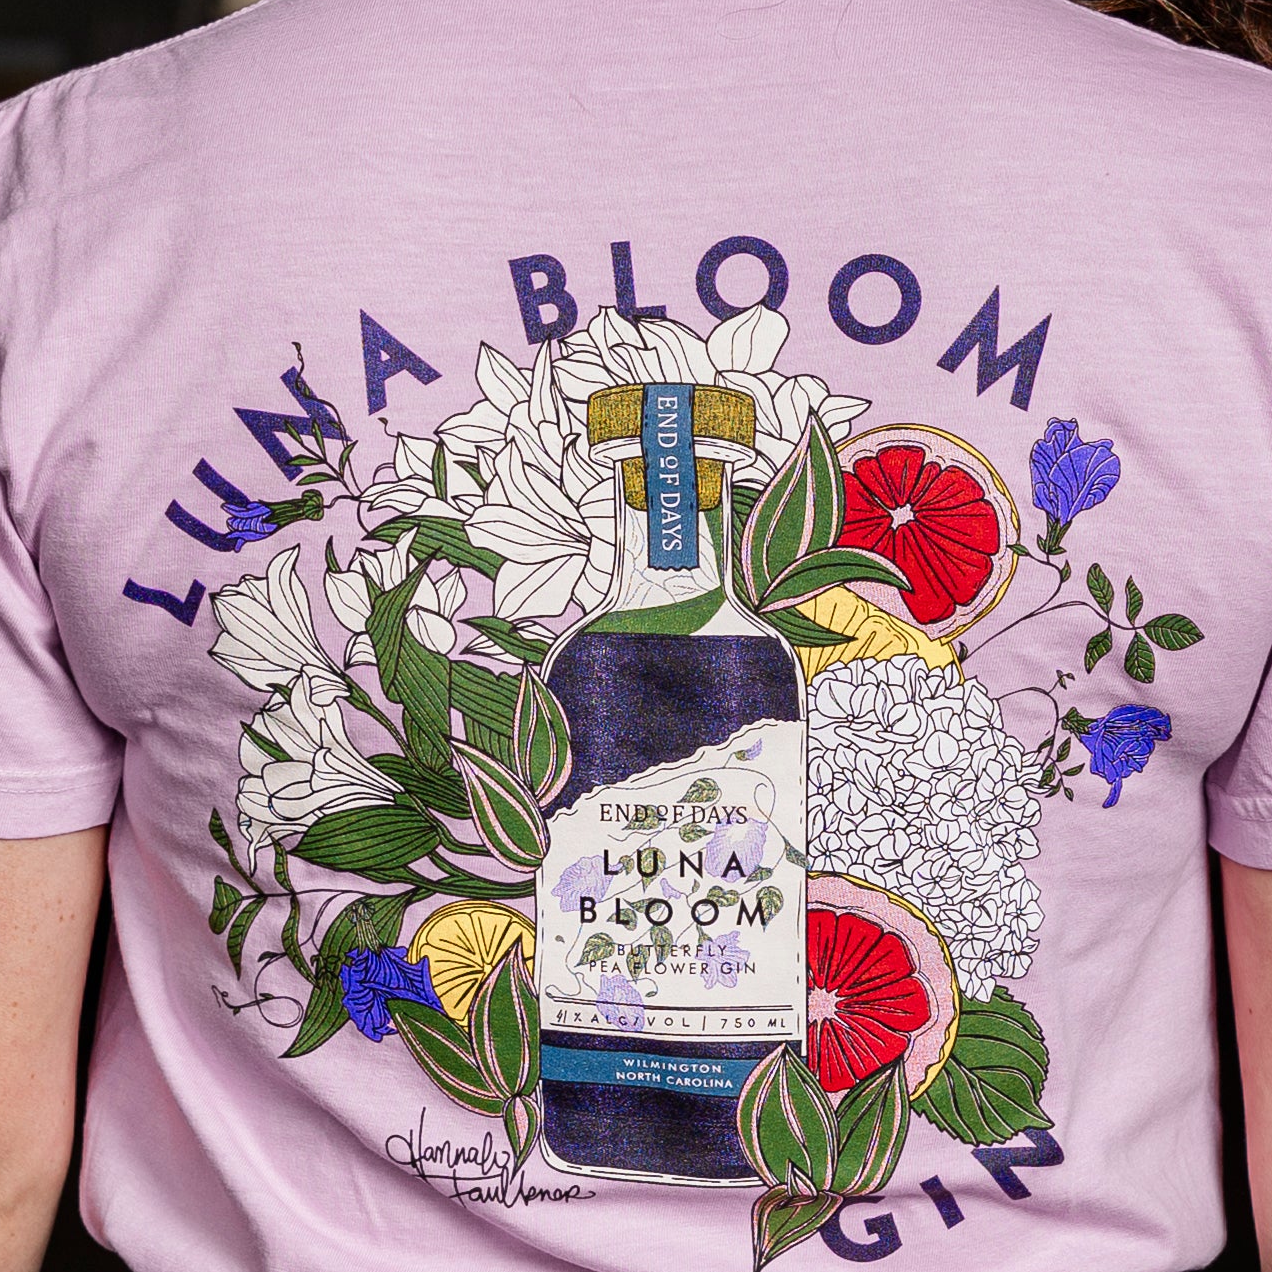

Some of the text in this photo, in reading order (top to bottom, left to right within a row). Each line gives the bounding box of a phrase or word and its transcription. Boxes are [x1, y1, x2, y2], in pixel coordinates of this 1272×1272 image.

[122, 234, 1052, 628] LUNA BLOOM
[657, 396, 679, 449] END
[659, 492, 684, 552] DAYS
[599, 803, 649, 823] END
[691, 805, 748, 825] DAYS
[603, 849, 747, 878] LUNA
[579, 895, 767, 927] BLOOM
[616, 943, 728, 958] BUTTERFLY
[588, 959, 757, 975] PEA FLOWER GIN
[720, 1017, 756, 1029] 750
[766, 1017, 787, 1029] ML
[616, 1071, 733, 1089] NORTH CAROLINA
[820, 1128, 1065, 1263] GIN
